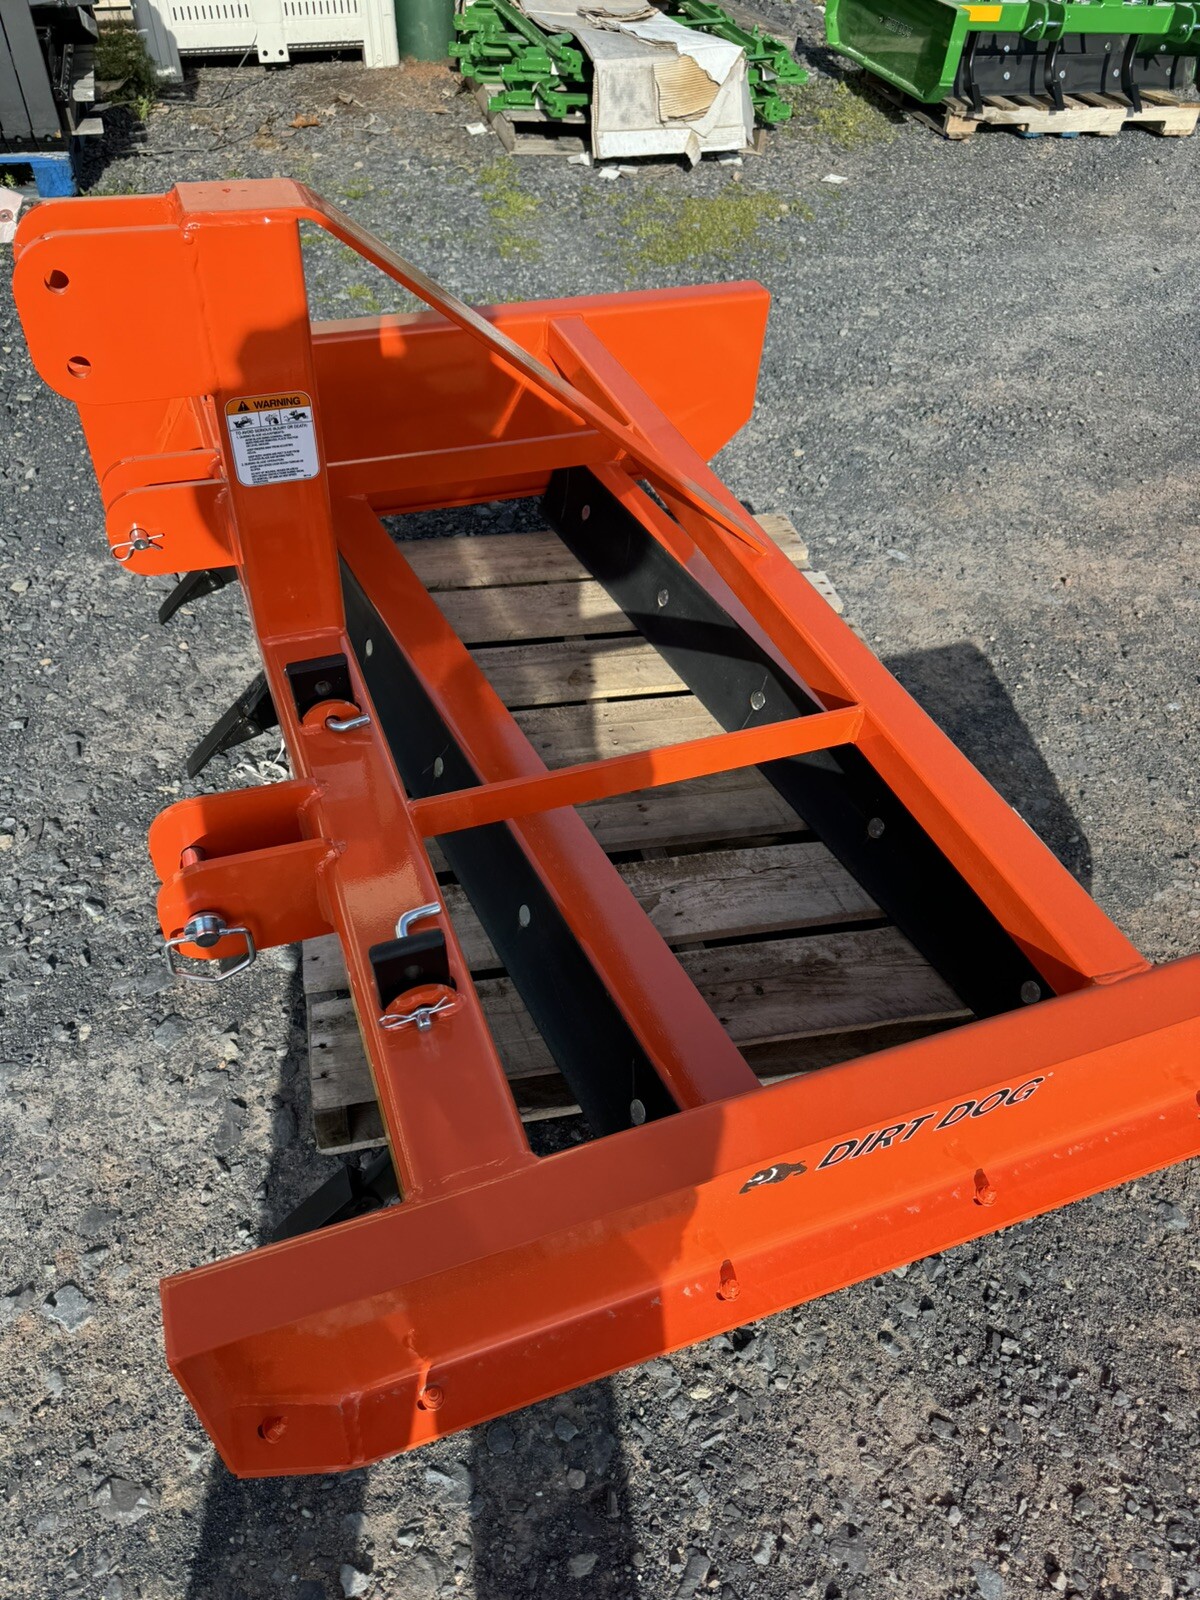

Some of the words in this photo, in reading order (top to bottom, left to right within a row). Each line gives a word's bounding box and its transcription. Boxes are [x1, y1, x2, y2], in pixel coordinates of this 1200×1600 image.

[253, 397, 301, 409] WARNING
[815, 1111, 939, 1170] DIRT
[933, 1075, 1045, 1131] DOG
